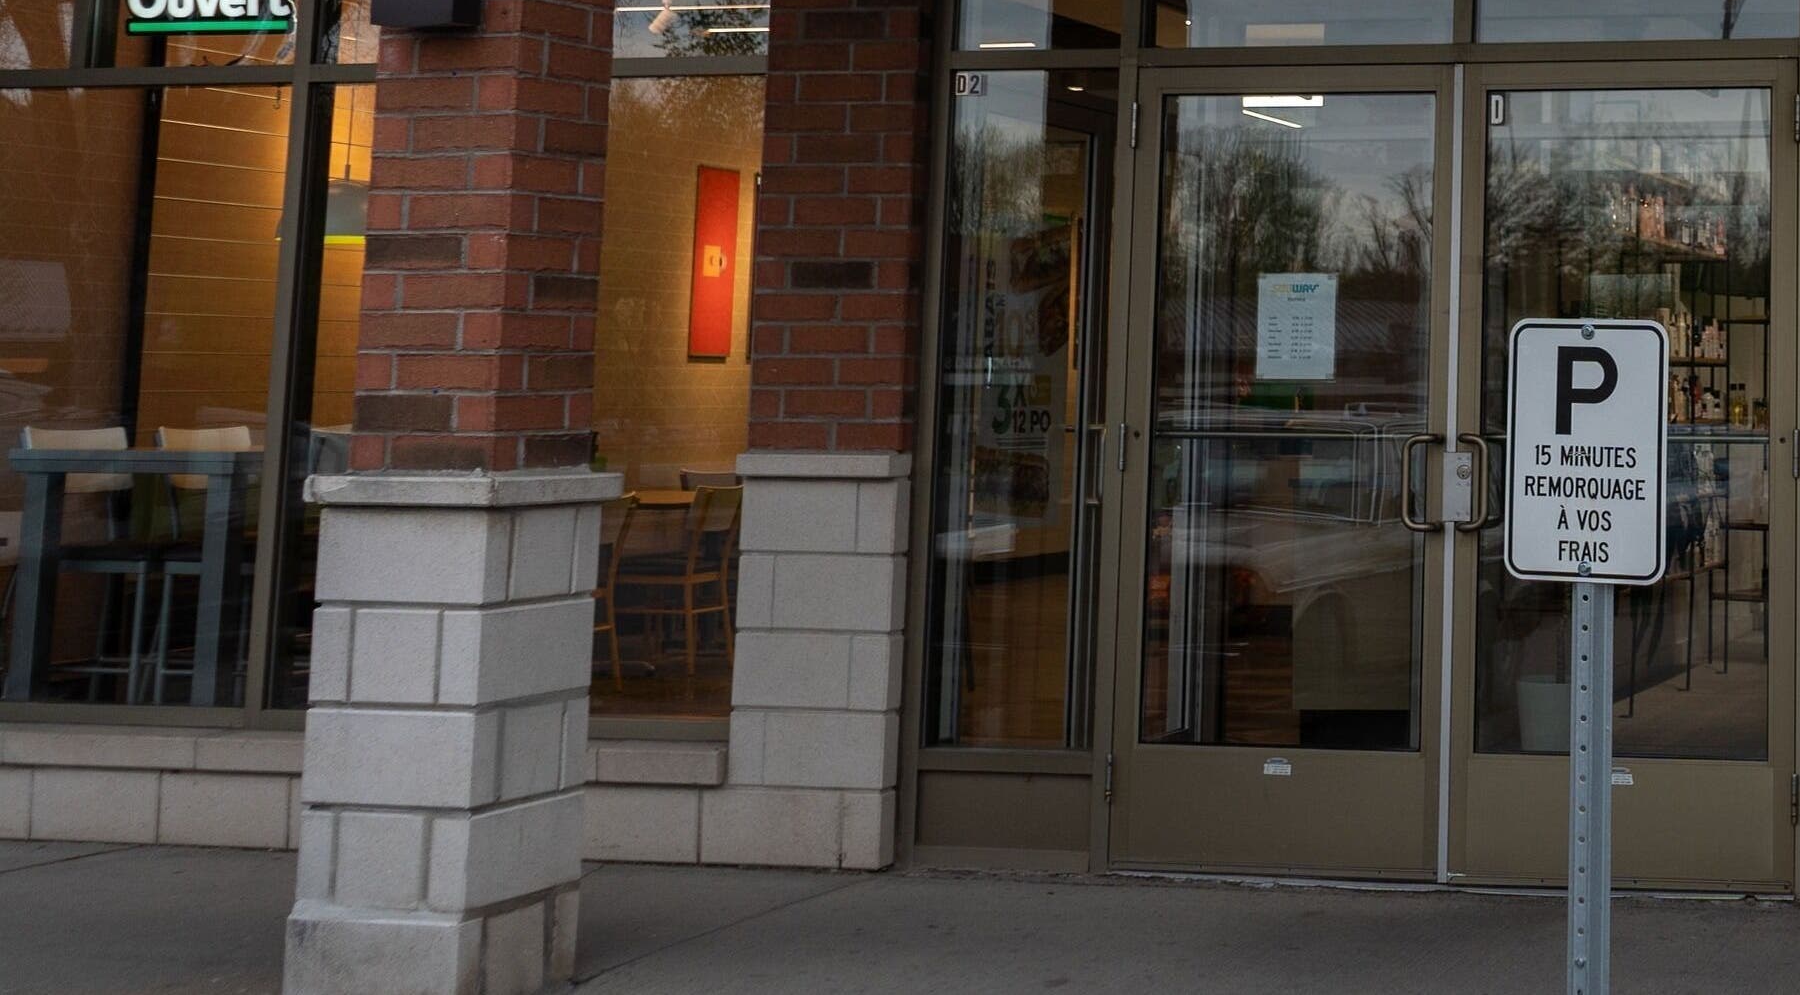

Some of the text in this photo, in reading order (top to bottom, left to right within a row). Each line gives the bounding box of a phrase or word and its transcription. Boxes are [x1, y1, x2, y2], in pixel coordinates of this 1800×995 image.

[1555, 346, 1619, 436] P
[1013, 410, 1051, 434] 12 PO
[1535, 445, 1637, 469] 15 MINUTES
[1524, 476, 1646, 501] REMORQUAGE
[1557, 505, 1612, 532] À VOS
[1558, 541, 1610, 563] FRAIS
